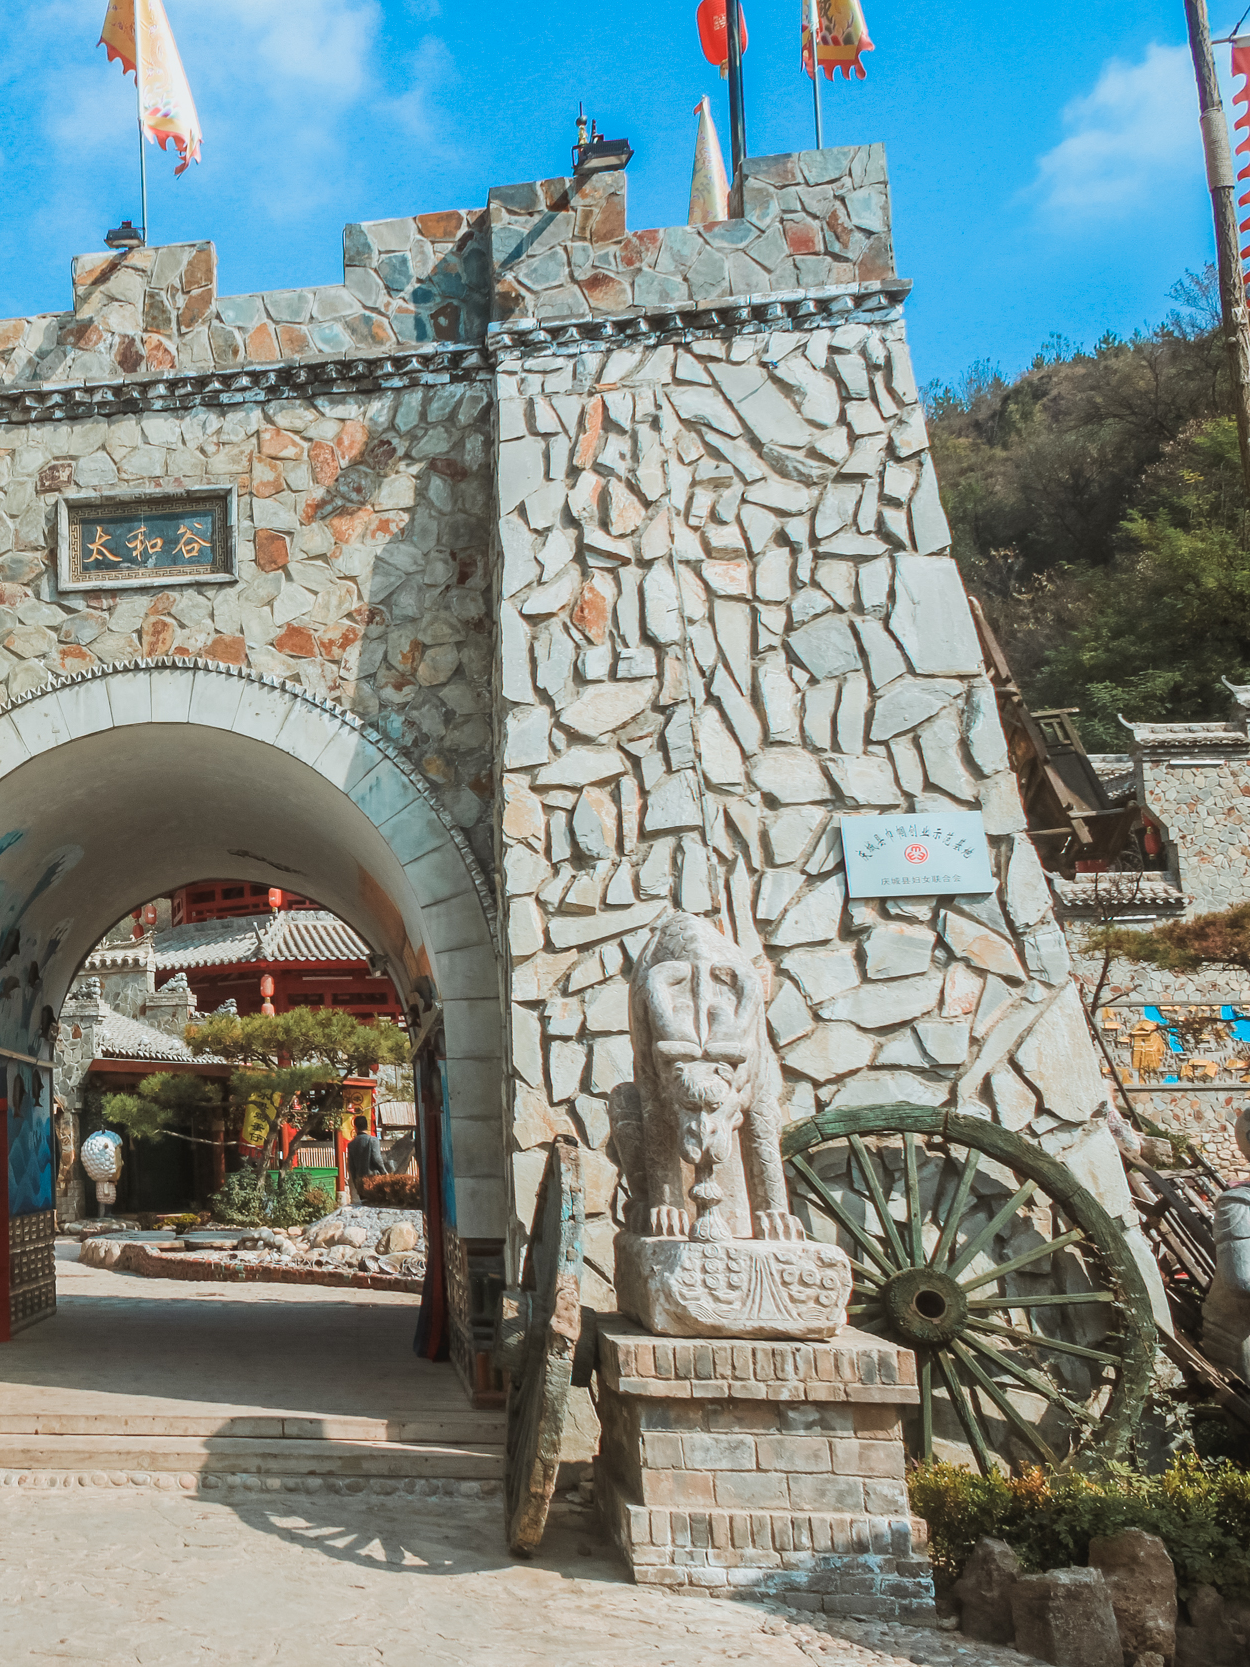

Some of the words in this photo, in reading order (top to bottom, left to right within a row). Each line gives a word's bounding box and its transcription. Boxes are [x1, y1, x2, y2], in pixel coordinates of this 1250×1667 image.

[83, 521, 212, 563] 太和谷
[880, 873, 962, 886] 庆城县妇女联合会
